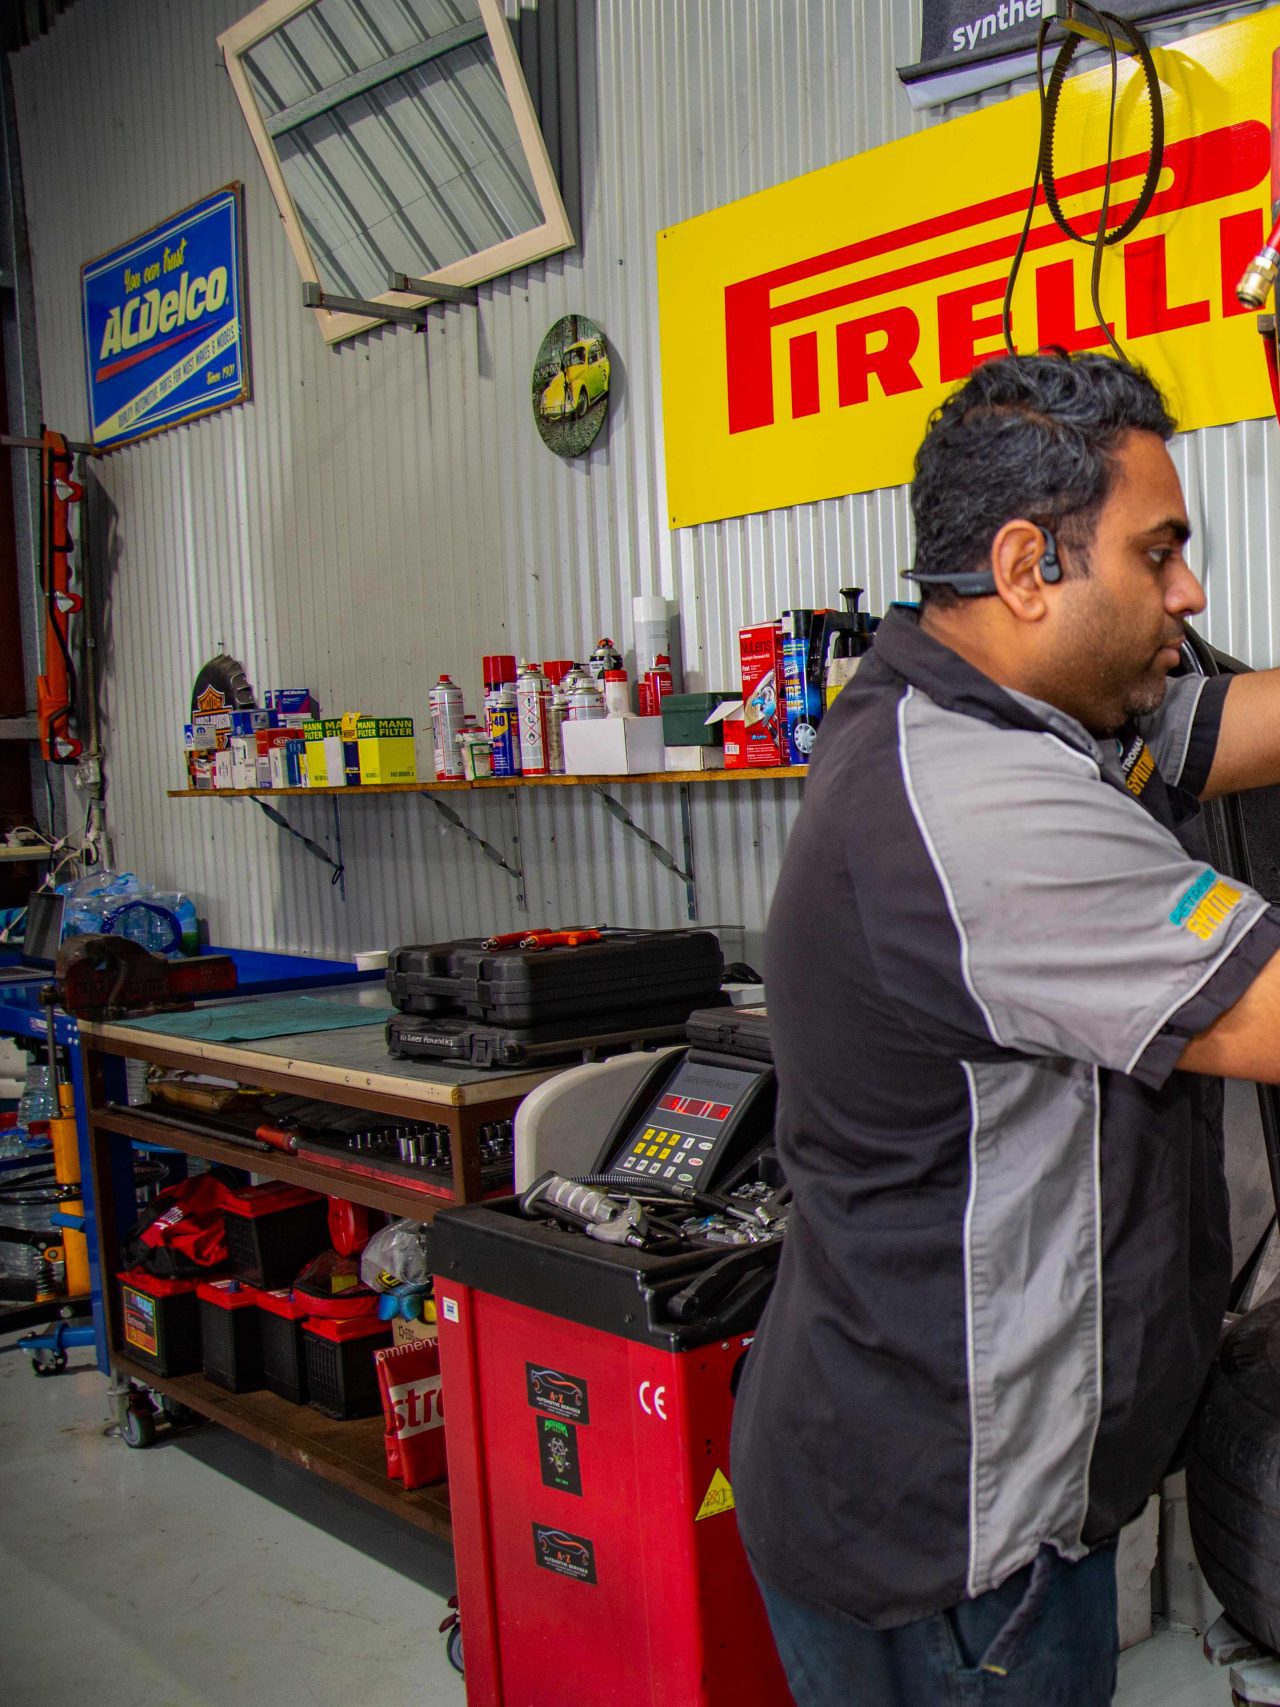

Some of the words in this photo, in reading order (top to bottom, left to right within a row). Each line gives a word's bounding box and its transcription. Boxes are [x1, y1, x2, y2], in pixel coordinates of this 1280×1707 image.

[124, 267, 141, 295] You
[144, 261, 161, 285] can
[163, 238, 187, 275] trust
[725, 119, 1272, 434] PIRELLI
[100, 265, 228, 361] ACDelco
[303, 721, 323, 731] MANN
[357, 720, 376, 729] MANN
[378, 720, 412, 728] MANN
[304, 731, 323, 741] FILTER
[358, 728, 377, 738] FILTER
[379, 728, 413, 736] FILTER
